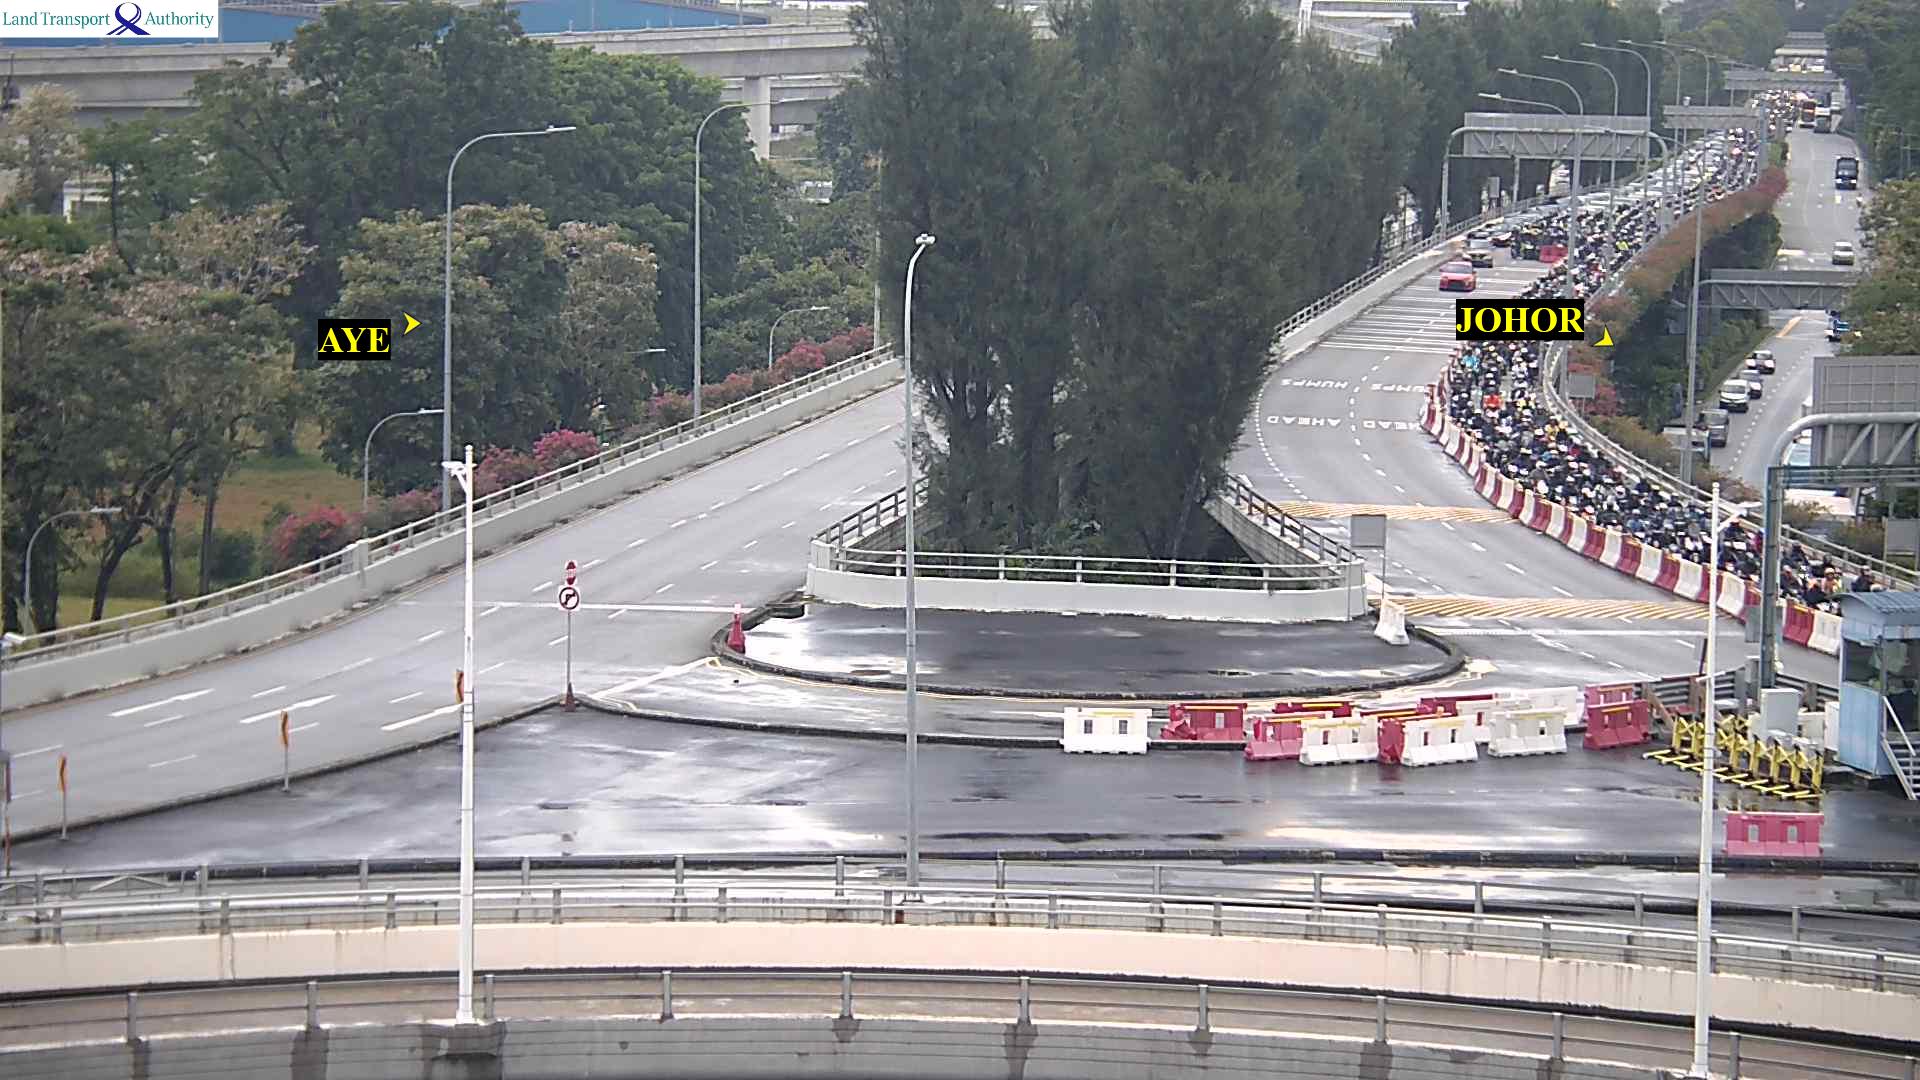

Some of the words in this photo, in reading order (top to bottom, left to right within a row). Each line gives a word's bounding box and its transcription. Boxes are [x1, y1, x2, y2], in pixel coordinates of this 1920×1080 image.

[1280, 377, 1349, 390] HUMPS
[1370, 383, 1425, 393] UMPS
[1266, 415, 1341, 427] AHEAD
[1363, 420, 1422, 431] HEAD
